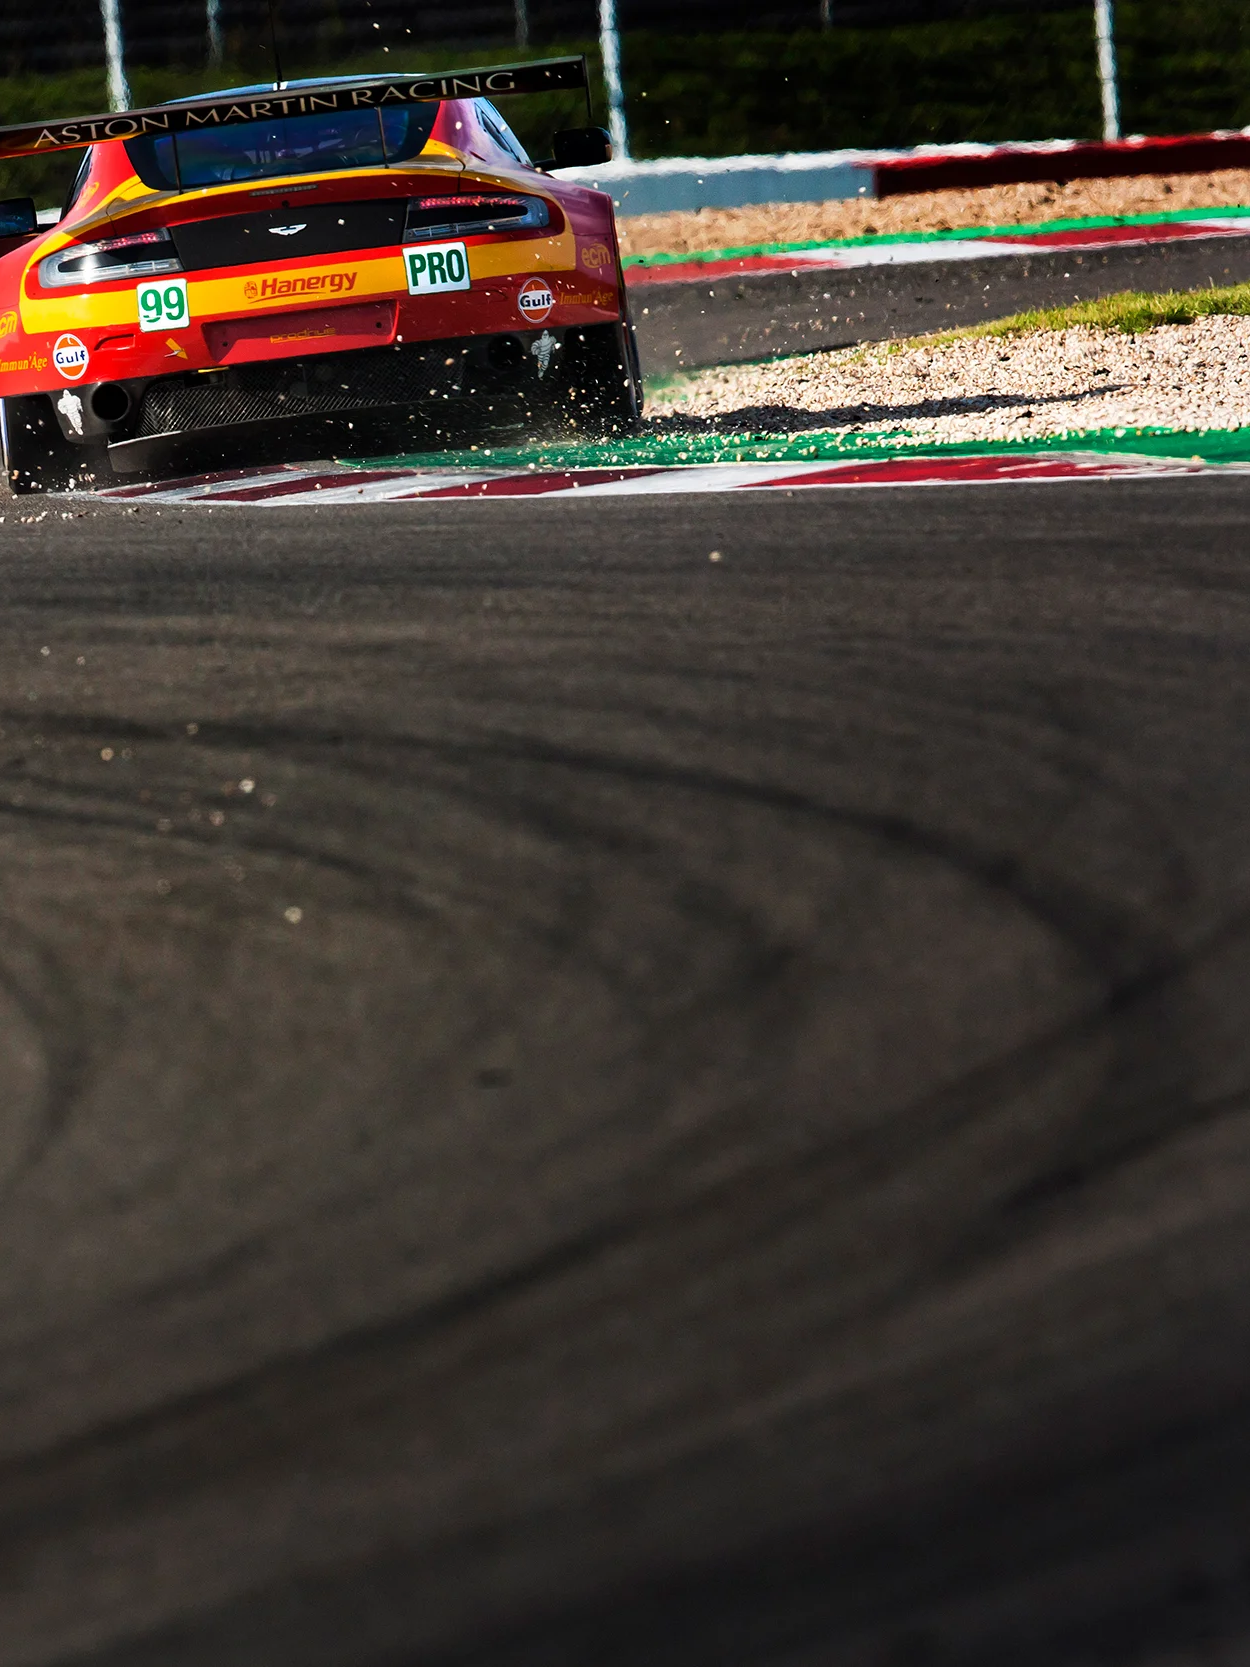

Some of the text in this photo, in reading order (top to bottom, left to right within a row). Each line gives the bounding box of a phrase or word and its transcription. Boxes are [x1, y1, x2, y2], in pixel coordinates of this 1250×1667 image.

[33, 72, 515, 148] ASTON MARTIN RACING
[408, 249, 465, 287] PRO
[581, 243, 611, 269] ecm
[260, 272, 358, 297] Hanergy
[140, 286, 185, 323] 99
[519, 293, 552, 308] Gulf
[55, 350, 86, 364] Gulf
